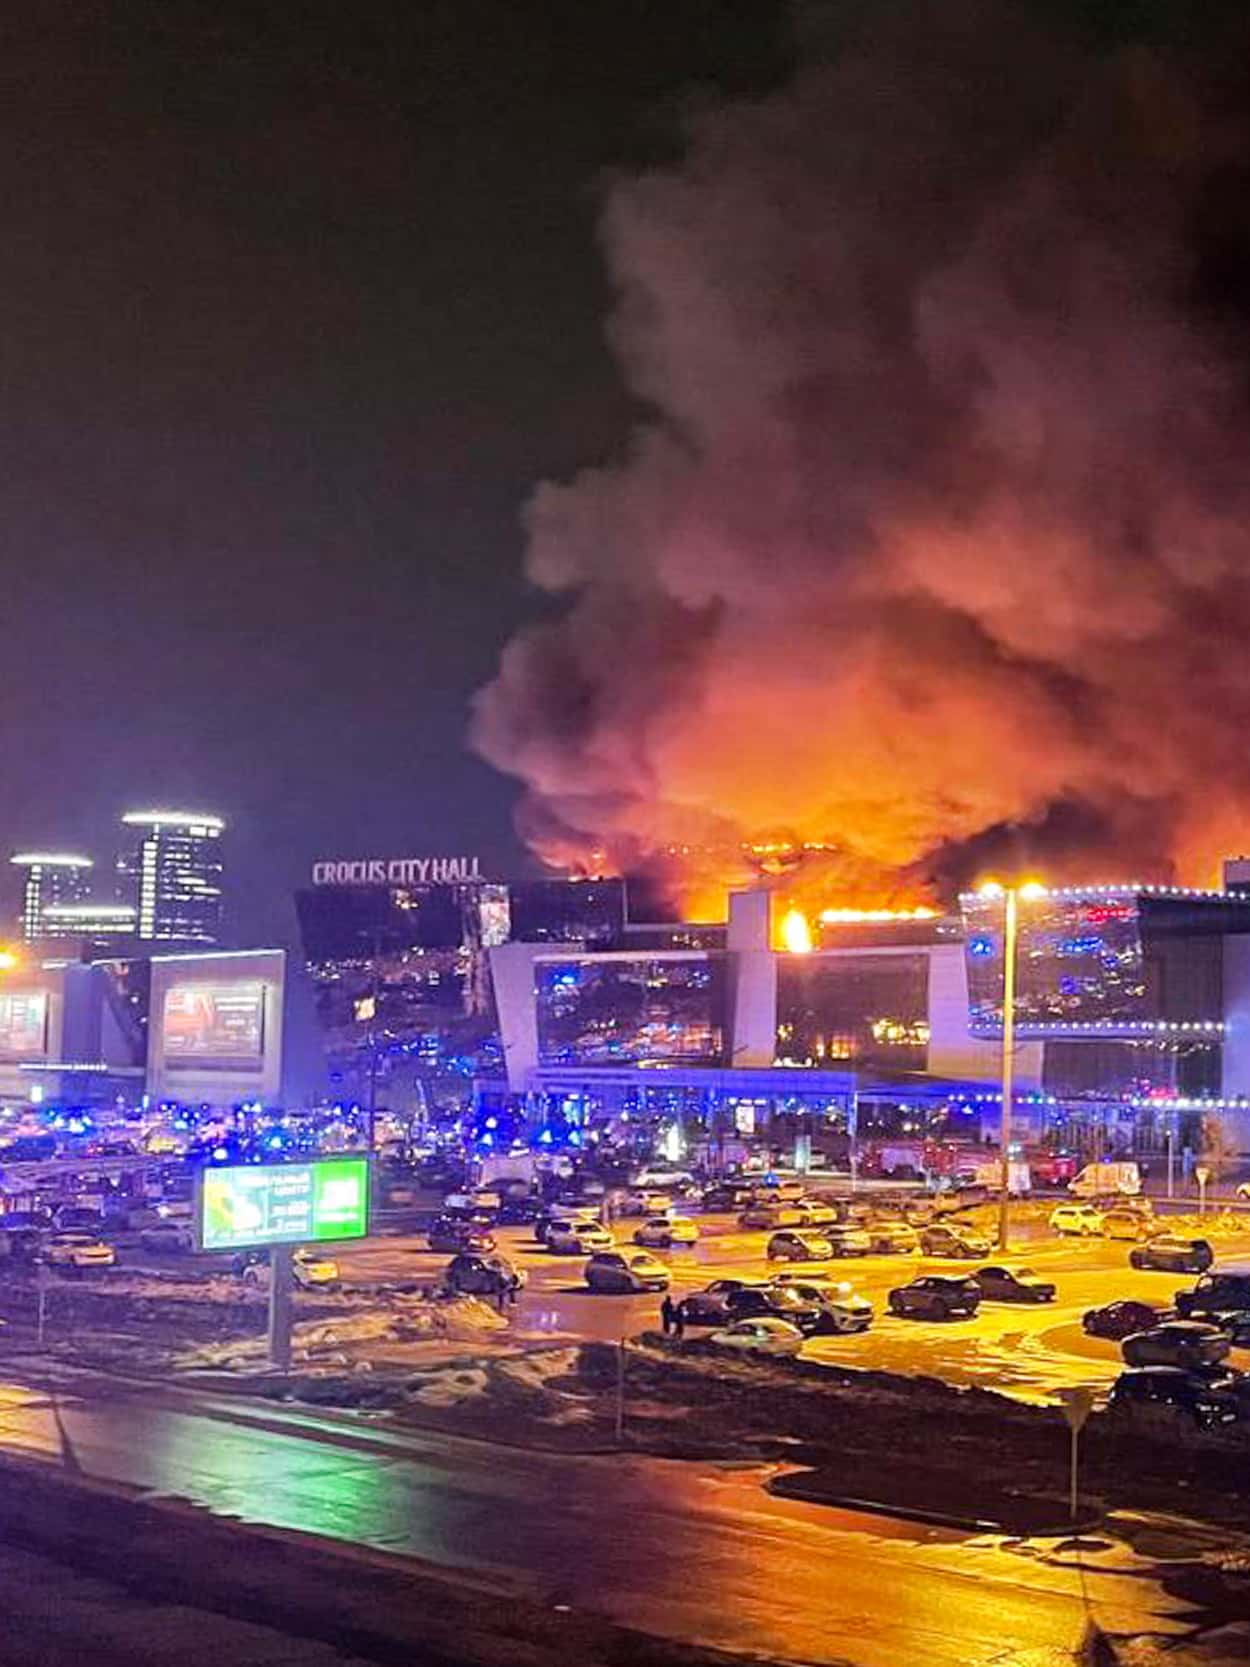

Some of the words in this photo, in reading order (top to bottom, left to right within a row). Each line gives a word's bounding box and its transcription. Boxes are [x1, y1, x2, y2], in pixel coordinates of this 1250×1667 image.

[312, 860, 386, 885] CROCUS
[388, 858, 430, 883] CITY
[432, 856, 486, 883] HALL
